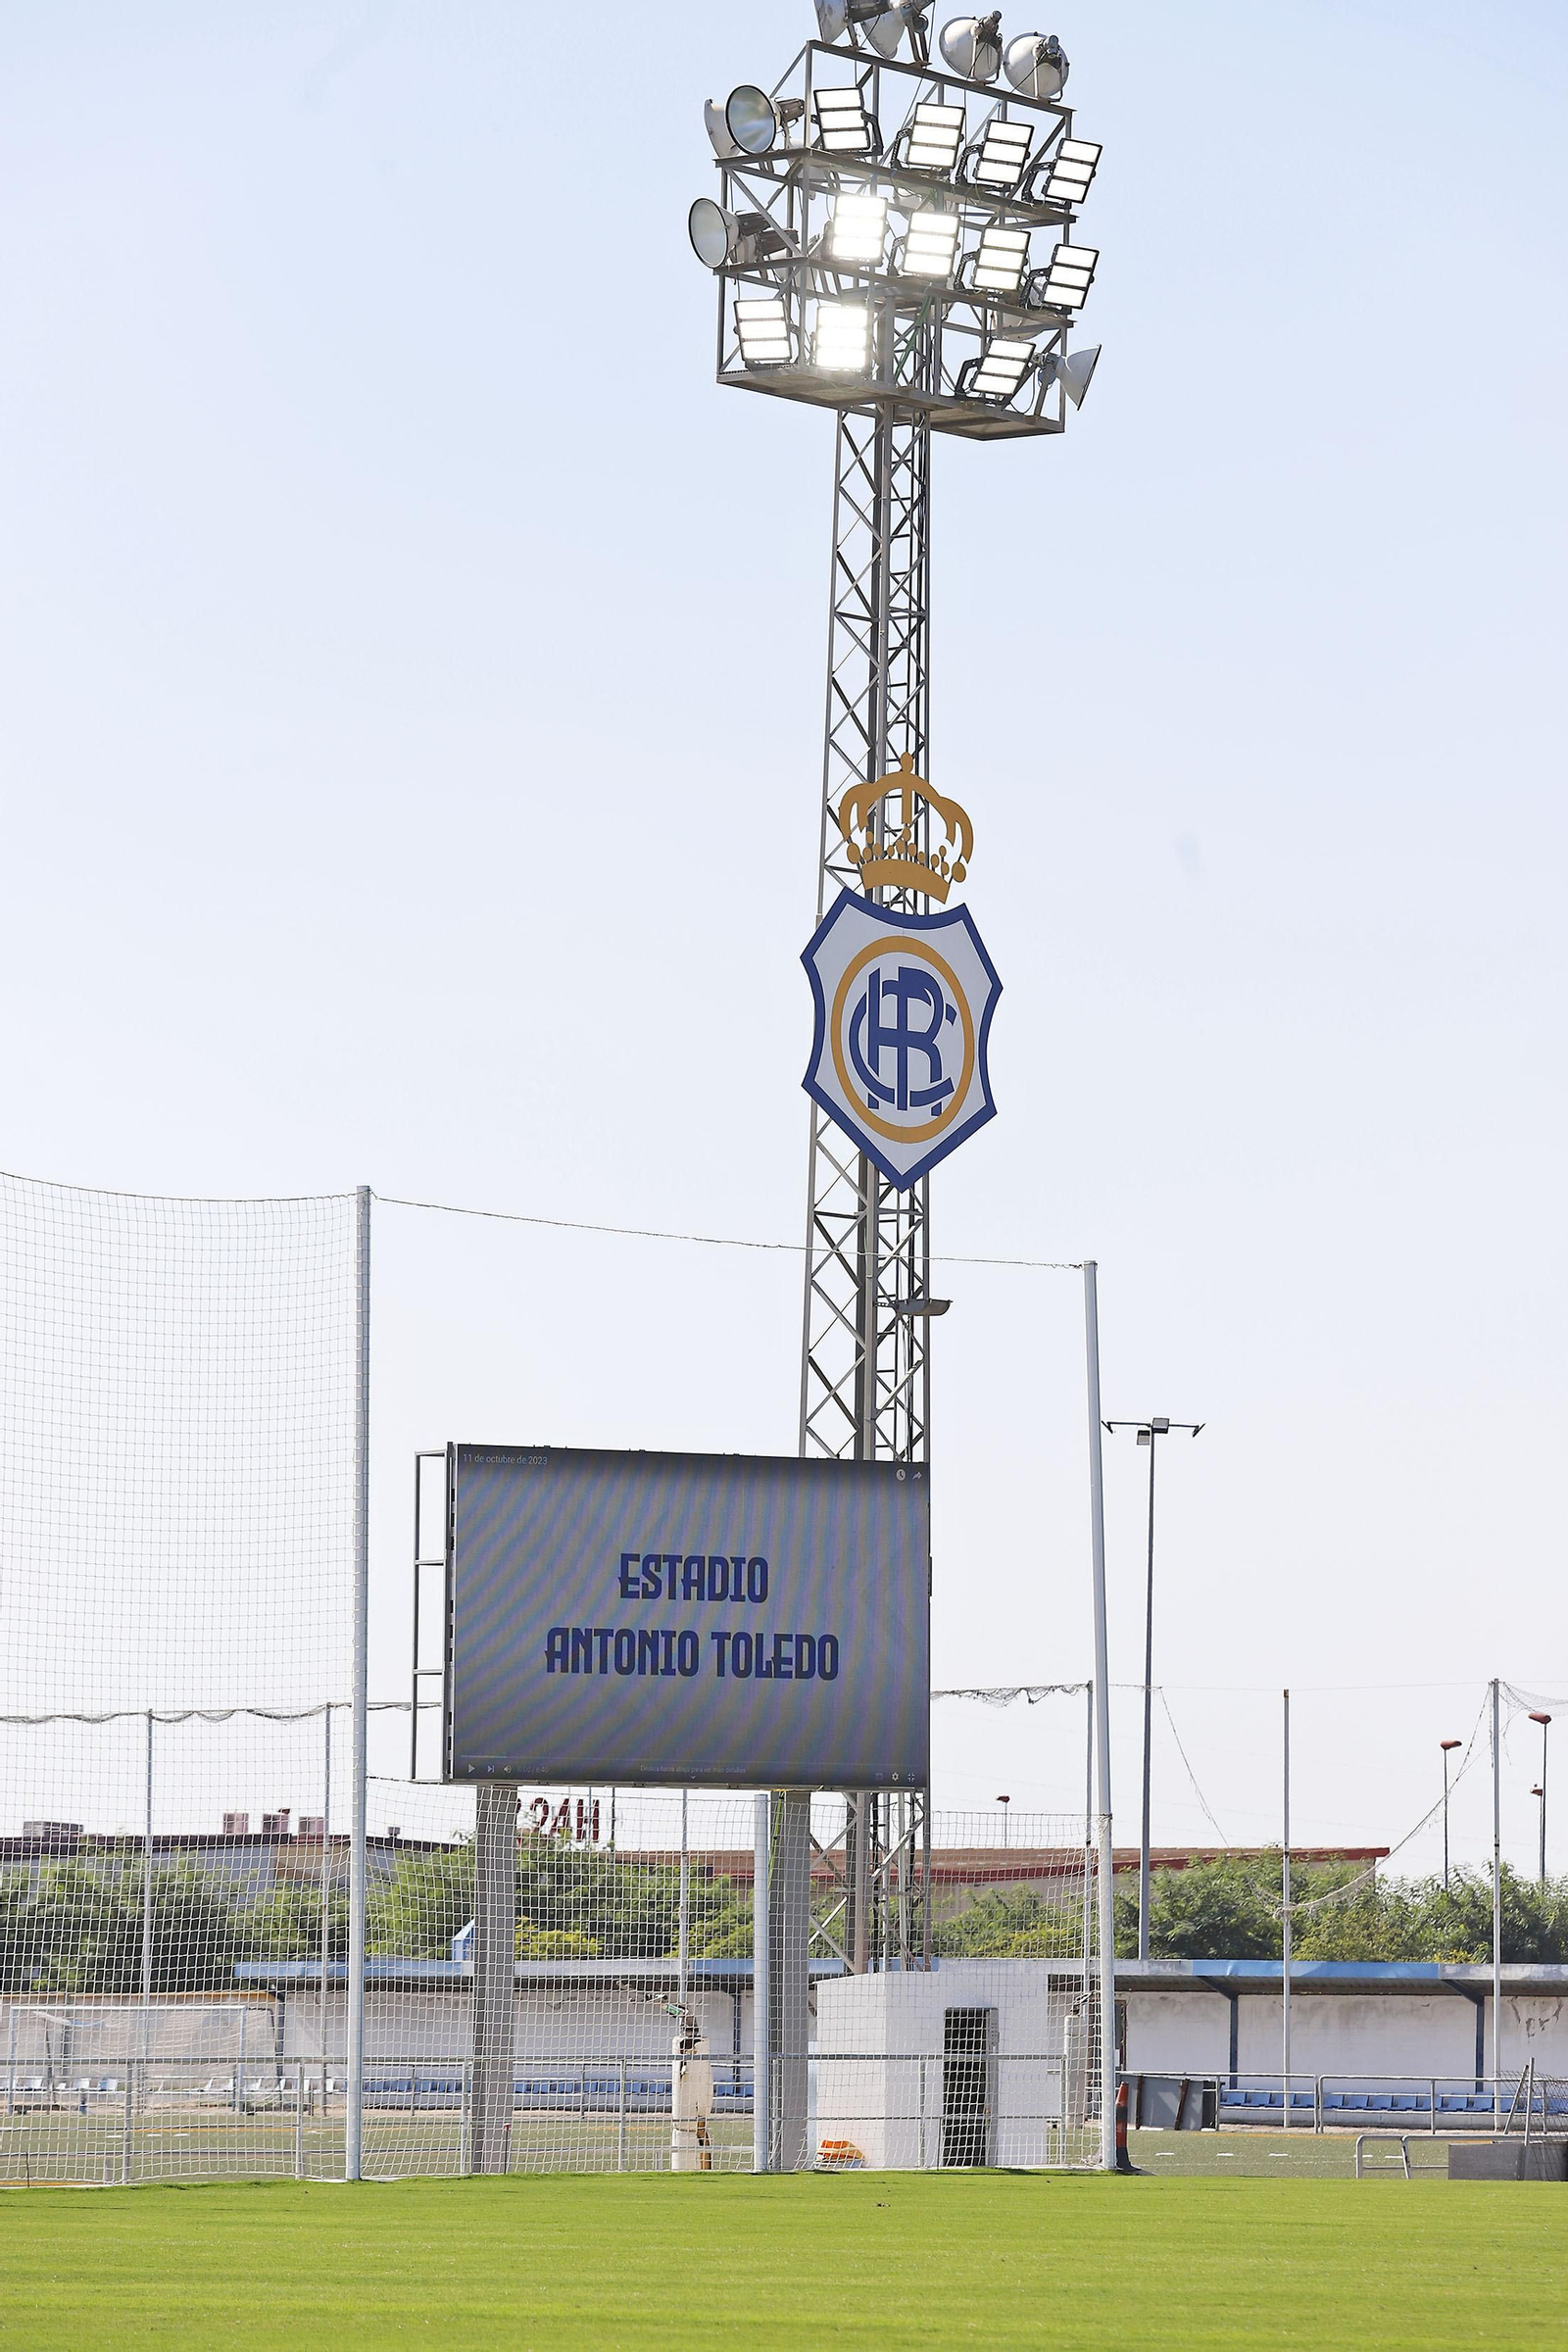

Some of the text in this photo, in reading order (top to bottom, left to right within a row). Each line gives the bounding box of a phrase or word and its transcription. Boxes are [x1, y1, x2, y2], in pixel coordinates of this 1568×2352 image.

[463, 1453, 548, 1465] 11 de octubre de 2023
[618, 1552, 768, 1603] ESTADIO
[545, 1627, 839, 1681] ANTONIO TOLEDO
[530, 1797, 599, 1842] 24H
